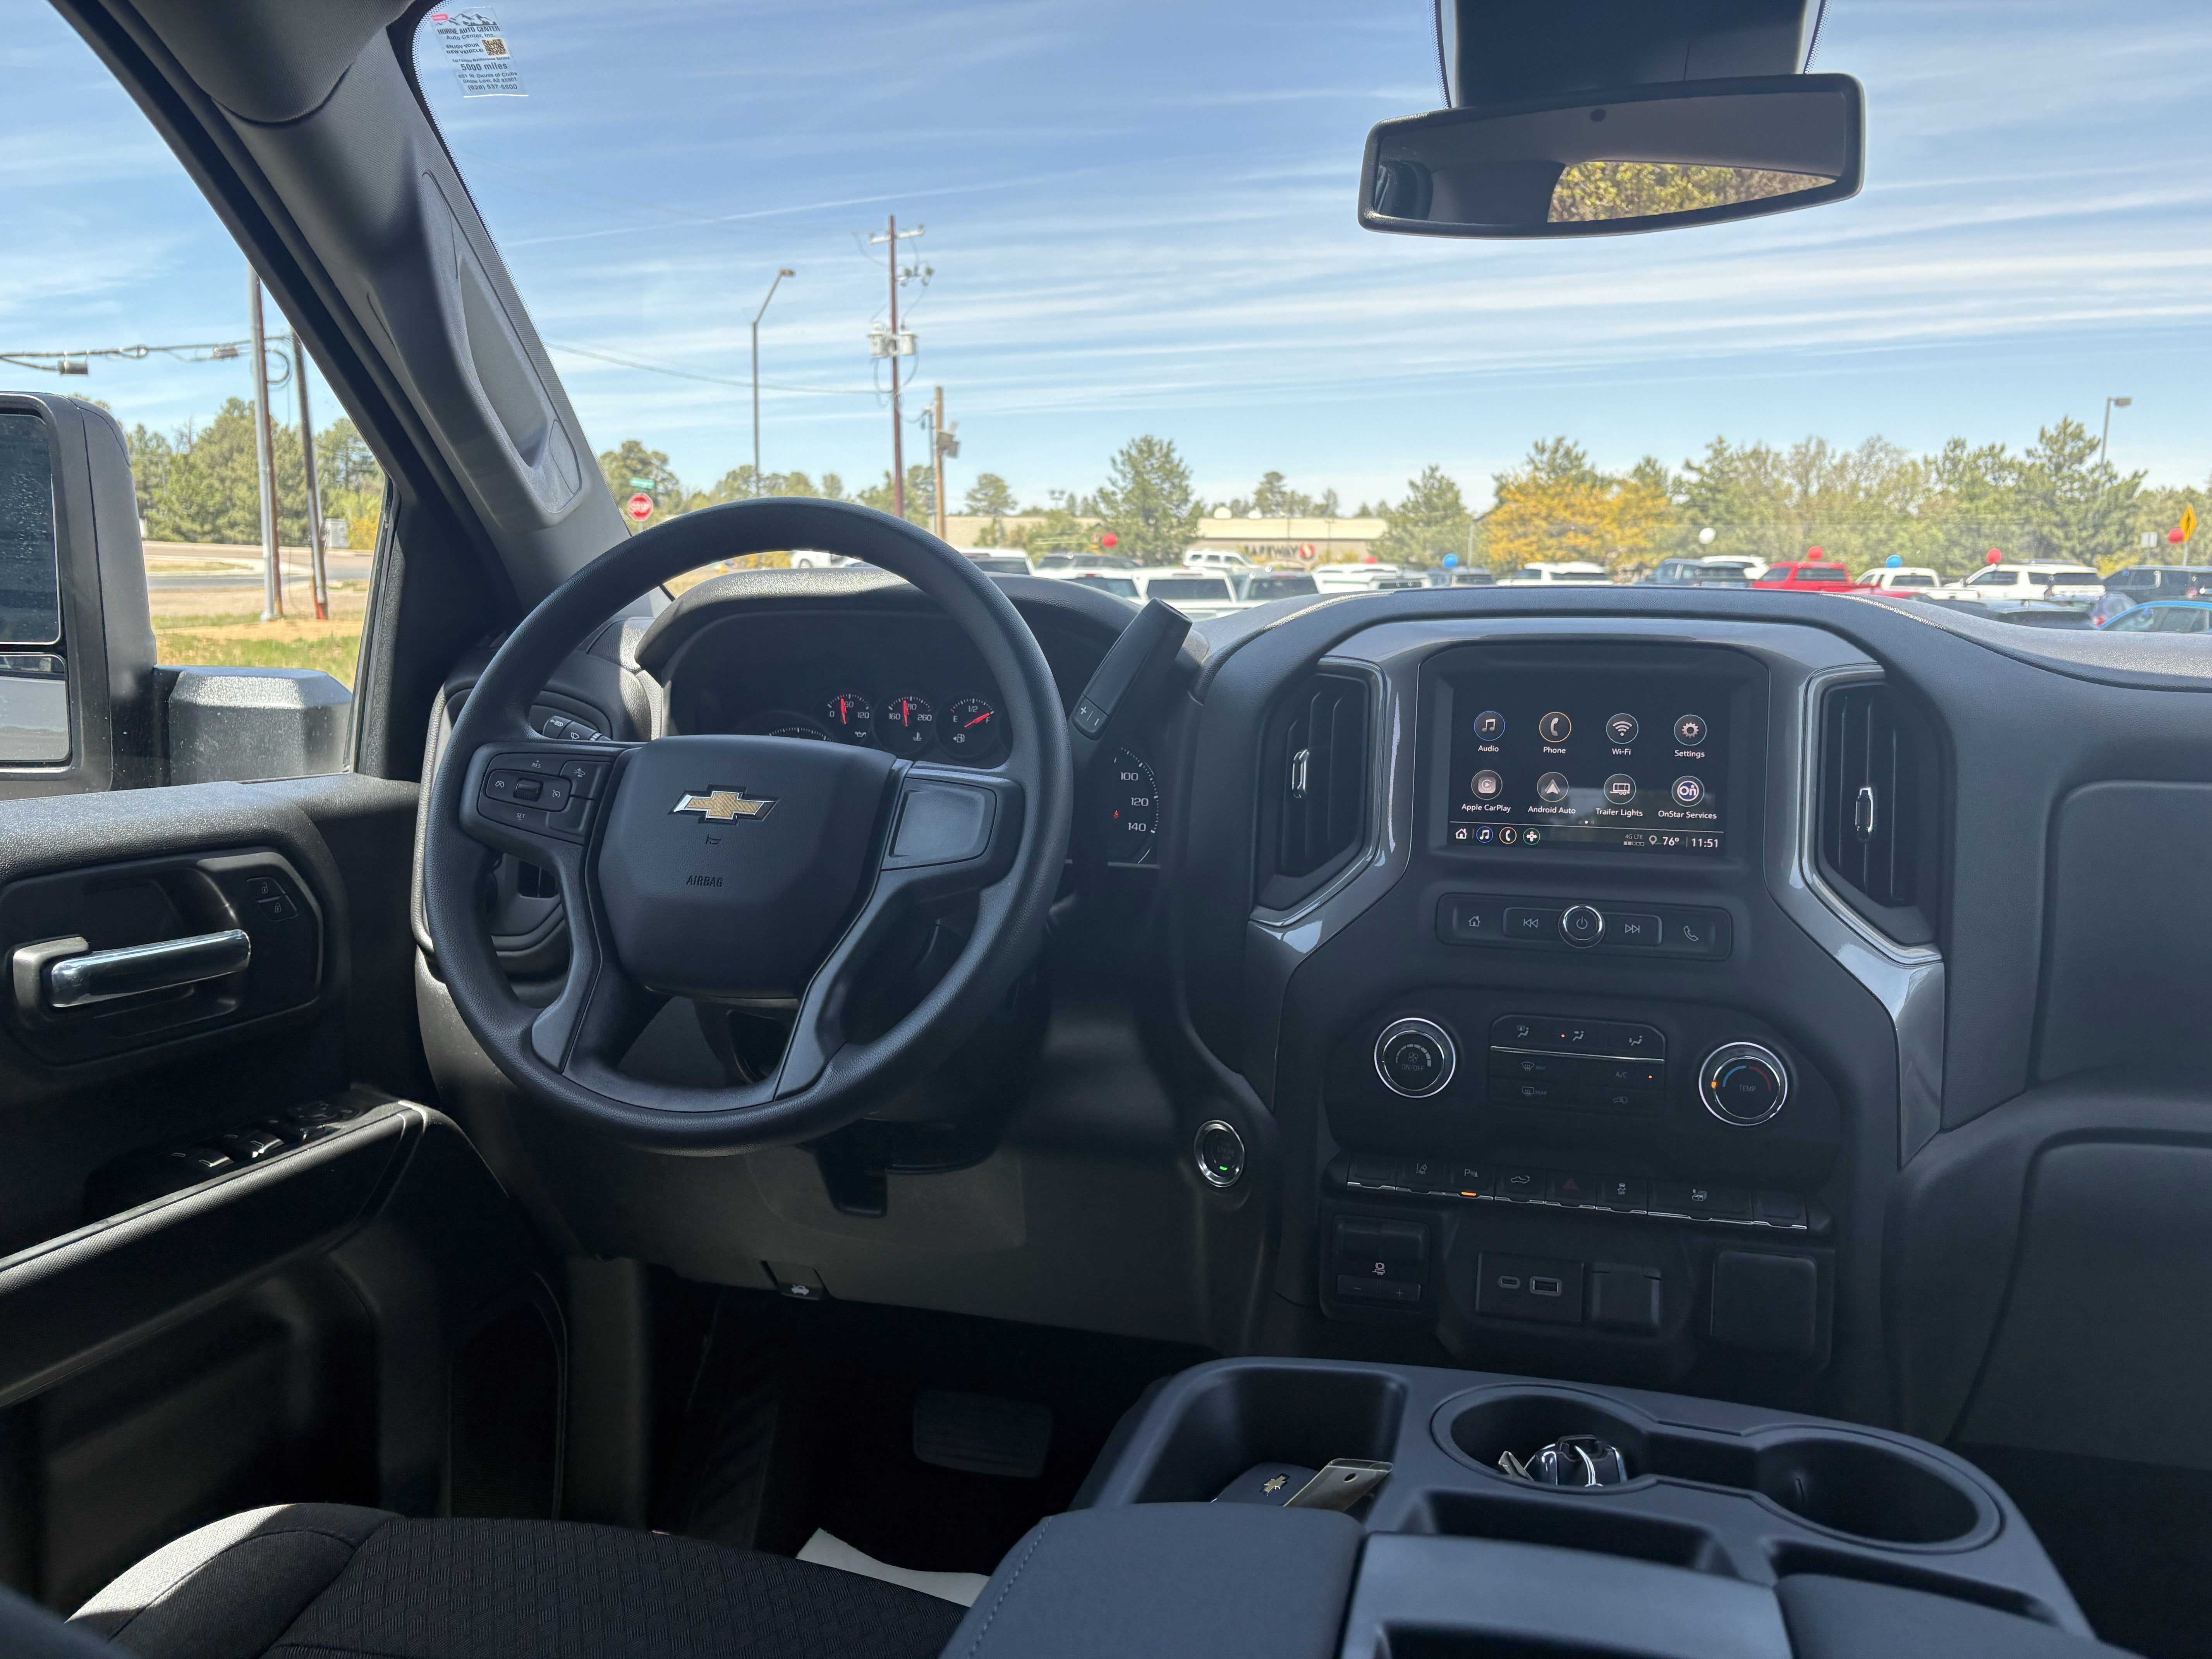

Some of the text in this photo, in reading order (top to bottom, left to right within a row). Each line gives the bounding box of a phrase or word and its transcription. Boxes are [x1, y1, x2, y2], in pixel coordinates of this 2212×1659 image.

[1674, 750, 1705, 758] Settings
[1120, 772, 1139, 781] 100
[1131, 797, 1149, 806] 120
[1462, 803, 1511, 813] Apple CarPlay
[1595, 808, 1643, 817] Trailer Lights
[1658, 810, 1717, 820] OnStar Services
[1128, 822, 1146, 831] 140
[1692, 838, 1718, 848] 11:51
[686, 874, 723, 888] AIRBAG
